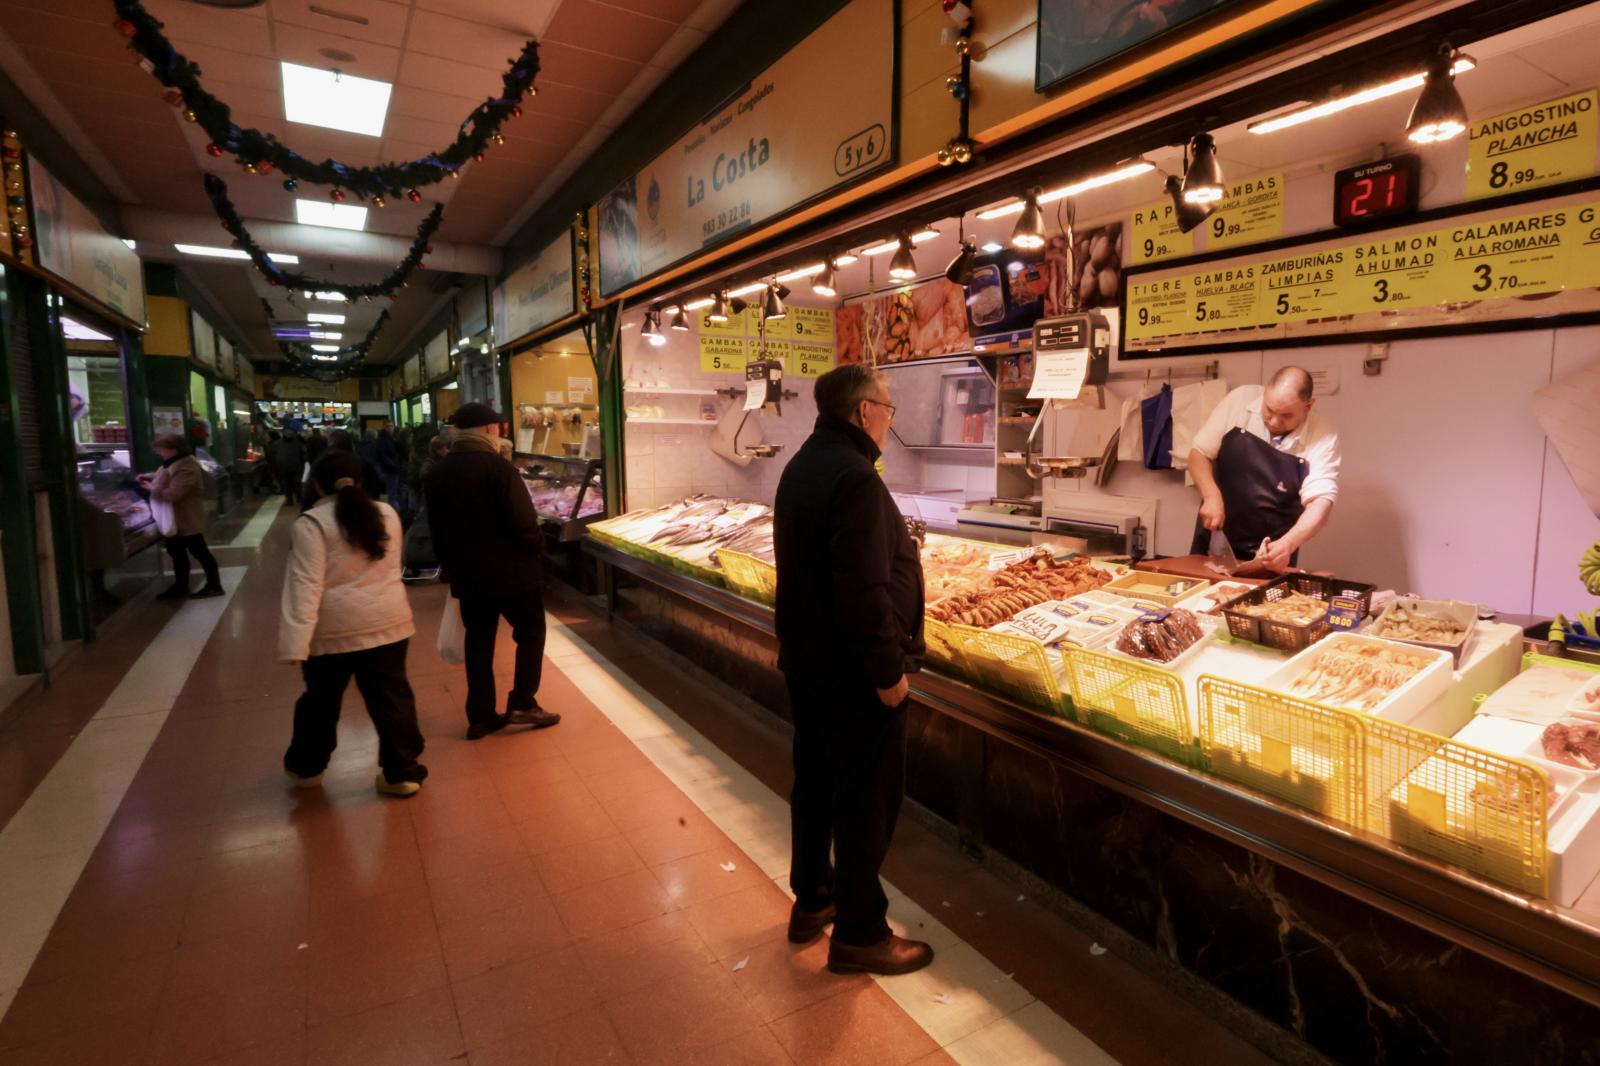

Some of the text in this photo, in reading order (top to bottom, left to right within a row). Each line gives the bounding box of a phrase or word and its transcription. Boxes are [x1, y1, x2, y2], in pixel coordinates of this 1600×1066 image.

[1469, 97, 1592, 140] LANGOSTINO
[1487, 121, 1578, 155] PLANCHA
[845, 134, 875, 168] 5 y 6
[687, 136, 770, 208] La Costa
[1367, 163, 1393, 175] TURNO
[1223, 177, 1277, 199] AMBAS
[1351, 175, 1396, 216] 21
[1135, 206, 1173, 226] RAP
[1213, 217, 1240, 238] 9,99
[1452, 212, 1566, 243] CALAMARES
[1144, 238, 1167, 258] 9,99
[1354, 235, 1437, 259] SALMON
[1454, 232, 1560, 258] A LA ROMANA
[1261, 252, 1344, 275] ZAMBURIÑAS
[1134, 280, 1182, 296] TIGRE
[1194, 268, 1254, 286] GAMBAS
[1268, 270, 1334, 288] LIMPIAS
[1472, 264, 1518, 292] 3,70
[1138, 307, 1161, 326] 9,99
[1195, 301, 1221, 322] 5,80
[700, 337, 743, 347] GAMBAS
